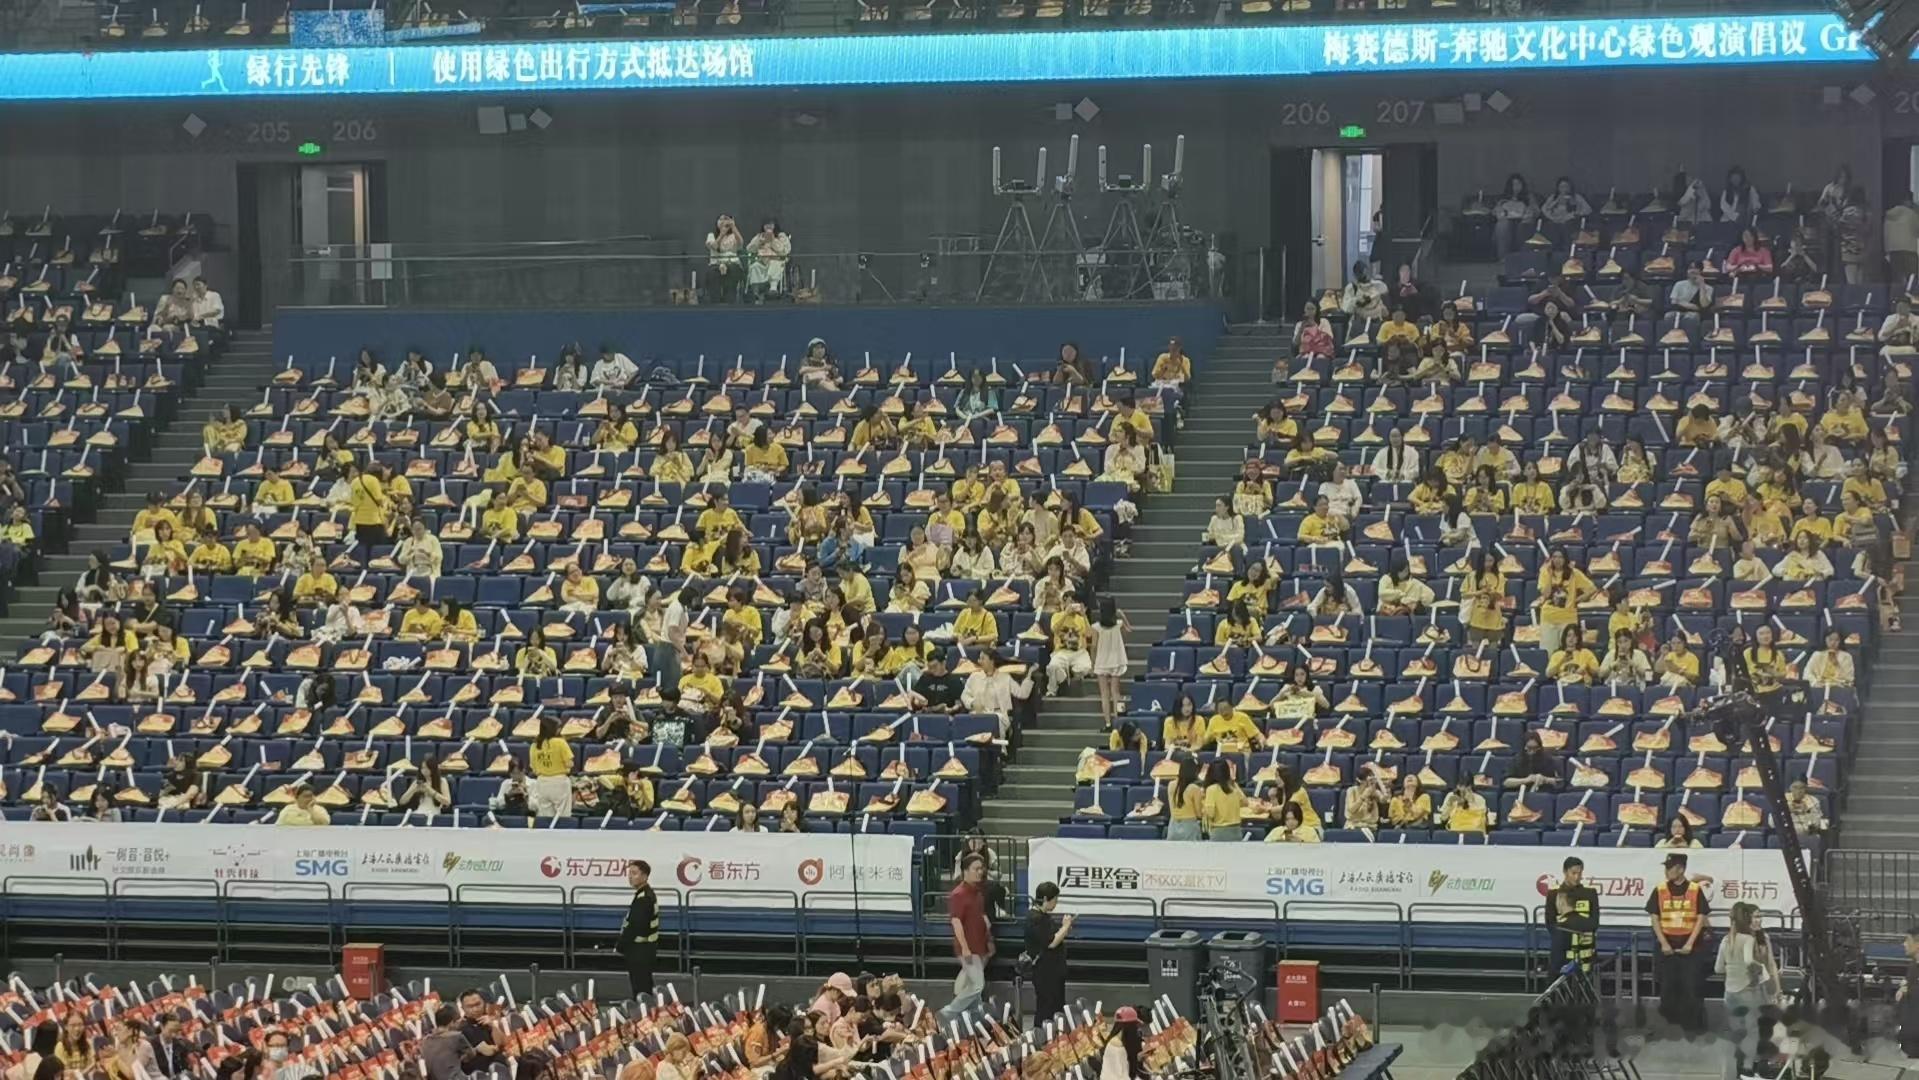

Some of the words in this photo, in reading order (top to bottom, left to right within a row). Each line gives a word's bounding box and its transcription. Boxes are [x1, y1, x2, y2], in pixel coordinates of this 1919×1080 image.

[1322, 20, 1807, 66] 梅赛德斯-奔驰文化中心绿色观演倡议
[246, 52, 350, 87] 绿行先锋
[432, 43, 755, 83] 使用绿色出行方式抵达场馆
[1282, 103, 1330, 125] 206
[1377, 101, 1425, 123] 207
[247, 122, 290, 142] 205
[332, 120, 376, 141] 206
[295, 860, 348, 876] SMG
[708, 862, 760, 881] 看东方
[1266, 867, 1324, 876] 上海广播电视台
[1144, 873, 1225, 888] 不仅仅是KTV
[1266, 877, 1324, 896] SMG
[1585, 875, 1645, 897] 方卫视
[1721, 879, 1778, 900] 看东方
